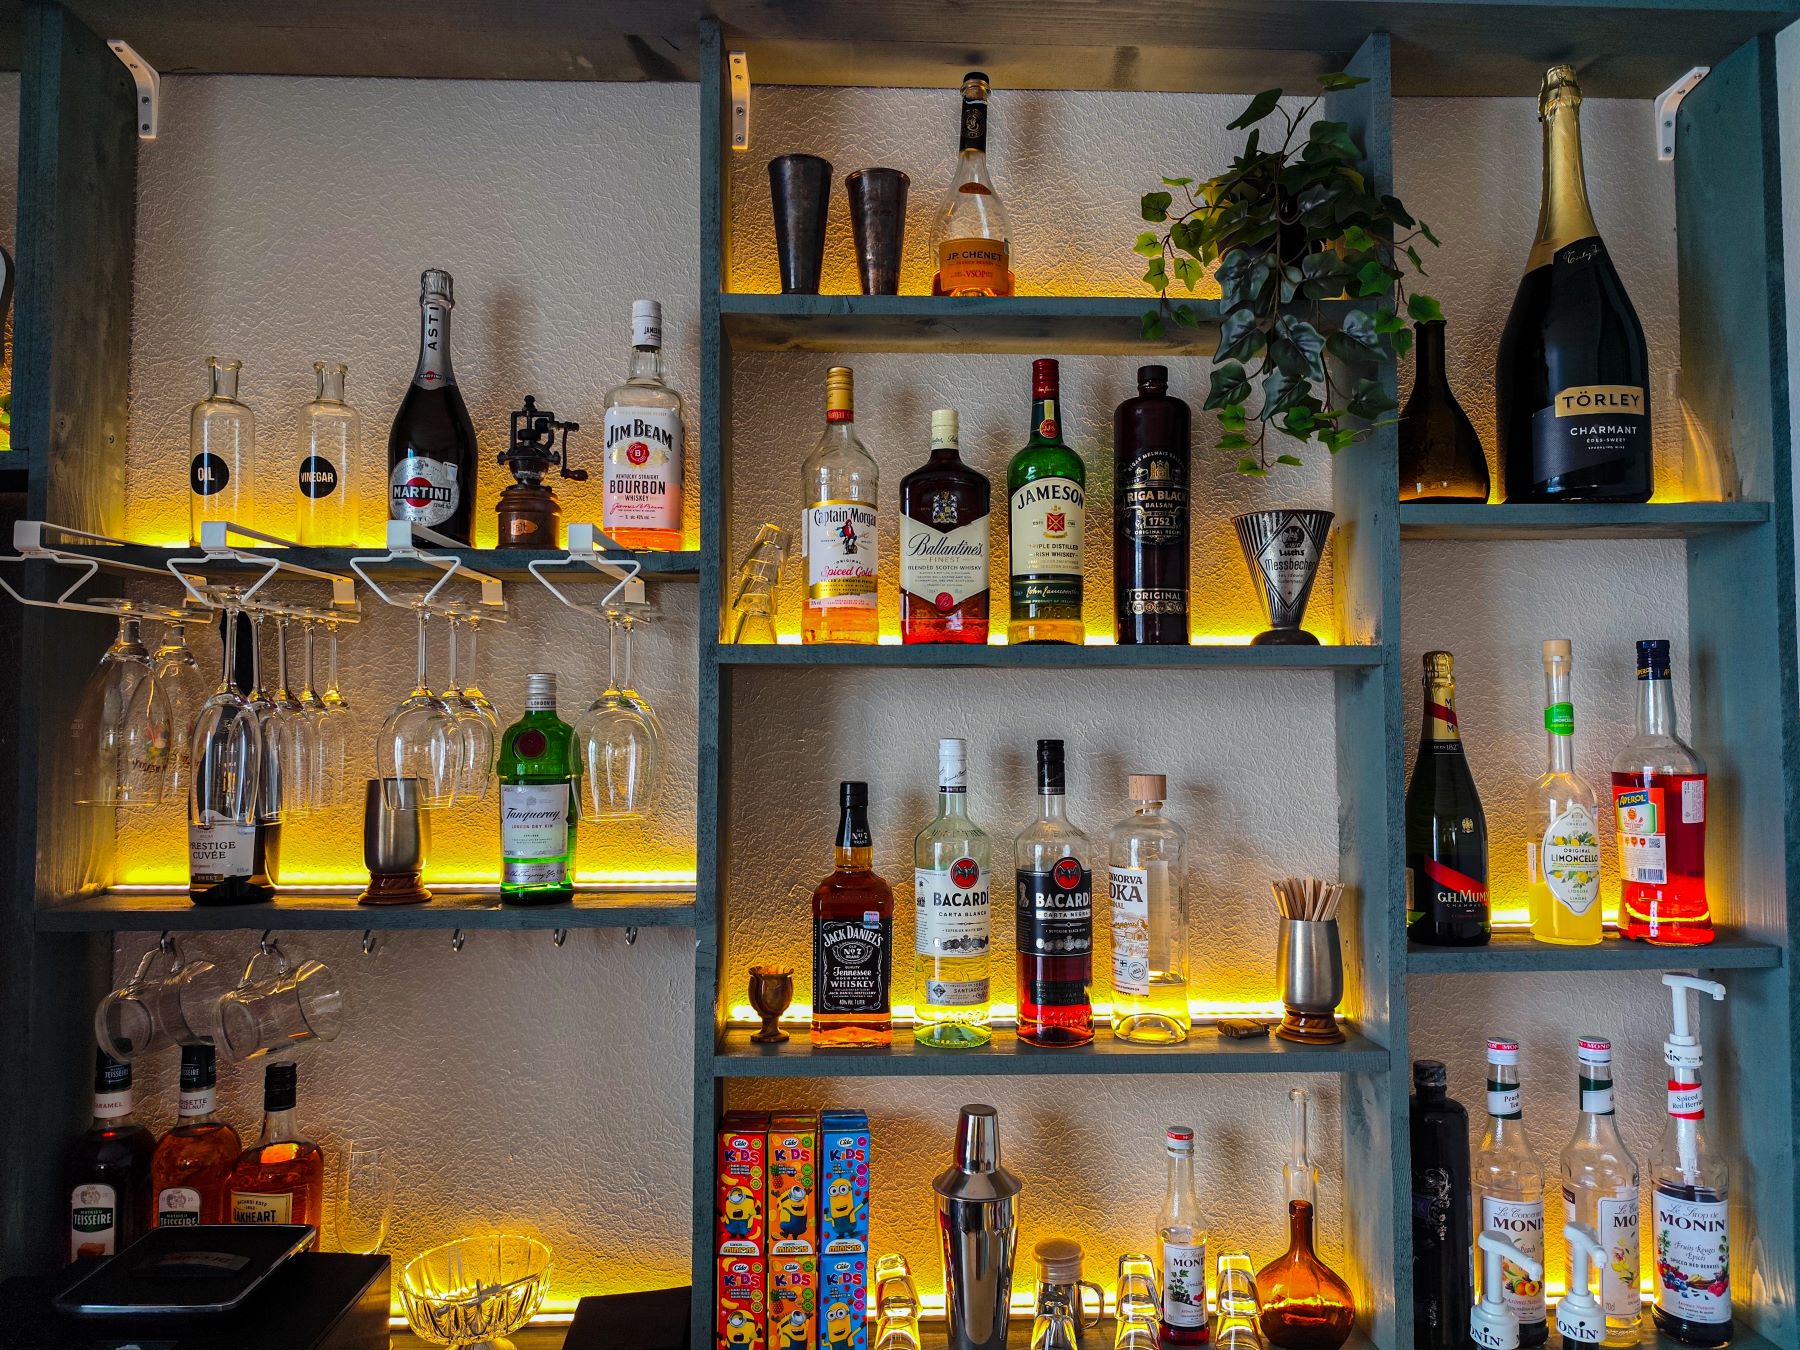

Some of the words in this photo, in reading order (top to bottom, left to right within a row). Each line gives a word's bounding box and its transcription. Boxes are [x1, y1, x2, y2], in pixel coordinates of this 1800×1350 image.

[962, 251, 1002, 261] CHENET
[427, 305, 440, 350] ASTI
[1562, 391, 1641, 410] TÖRLEY
[606, 423, 632, 449] JIM
[633, 418, 673, 451] BEAM
[1570, 426, 1638, 436] CHARMANT
[197, 467, 215, 481] OIL
[300, 471, 334, 484] VINEGAR
[393, 485, 450, 501] MARTINI
[609, 480, 666, 495] BOURBON
[625, 494, 649, 502] WHISKEY
[1017, 484, 1084, 510] JAMESON
[1127, 490, 1155, 502] RIGA
[1157, 490, 1188, 502] BLACK
[814, 507, 848, 527] Captain
[1148, 517, 1171, 526] 1752
[906, 533, 984, 557] Ballantine's
[821, 566, 853, 578] Spiced
[855, 566, 873, 578] Gold
[1134, 591, 1182, 600] ORIGINAL
[1619, 793, 1647, 807] APEROL
[506, 807, 561, 823] Tanqueray
[192, 850, 226, 860] CUVÉE
[1551, 854, 1599, 863] LIMONCELLO
[1043, 911, 1068, 919] CARTA
[823, 928, 845, 947] JACK
[846, 925, 884, 948] DANIEL'S
[832, 966, 872, 977] Tennessee
[830, 980, 875, 988] WHISKEY
[1504, 1094, 1520, 1103] Peach
[1676, 1093, 1699, 1103] Spiced
[1672, 1102, 1684, 1110] Red
[1684, 1100, 1704, 1109] Berrie
[73, 1212, 112, 1226] TEISSEIRE
[1659, 1210, 1727, 1233] MONIN
[723, 1246, 756, 1254] minions
[776, 1245, 809, 1253] minions
[828, 1244, 862, 1253] minions
[1556, 1321, 1598, 1340] ONIN
